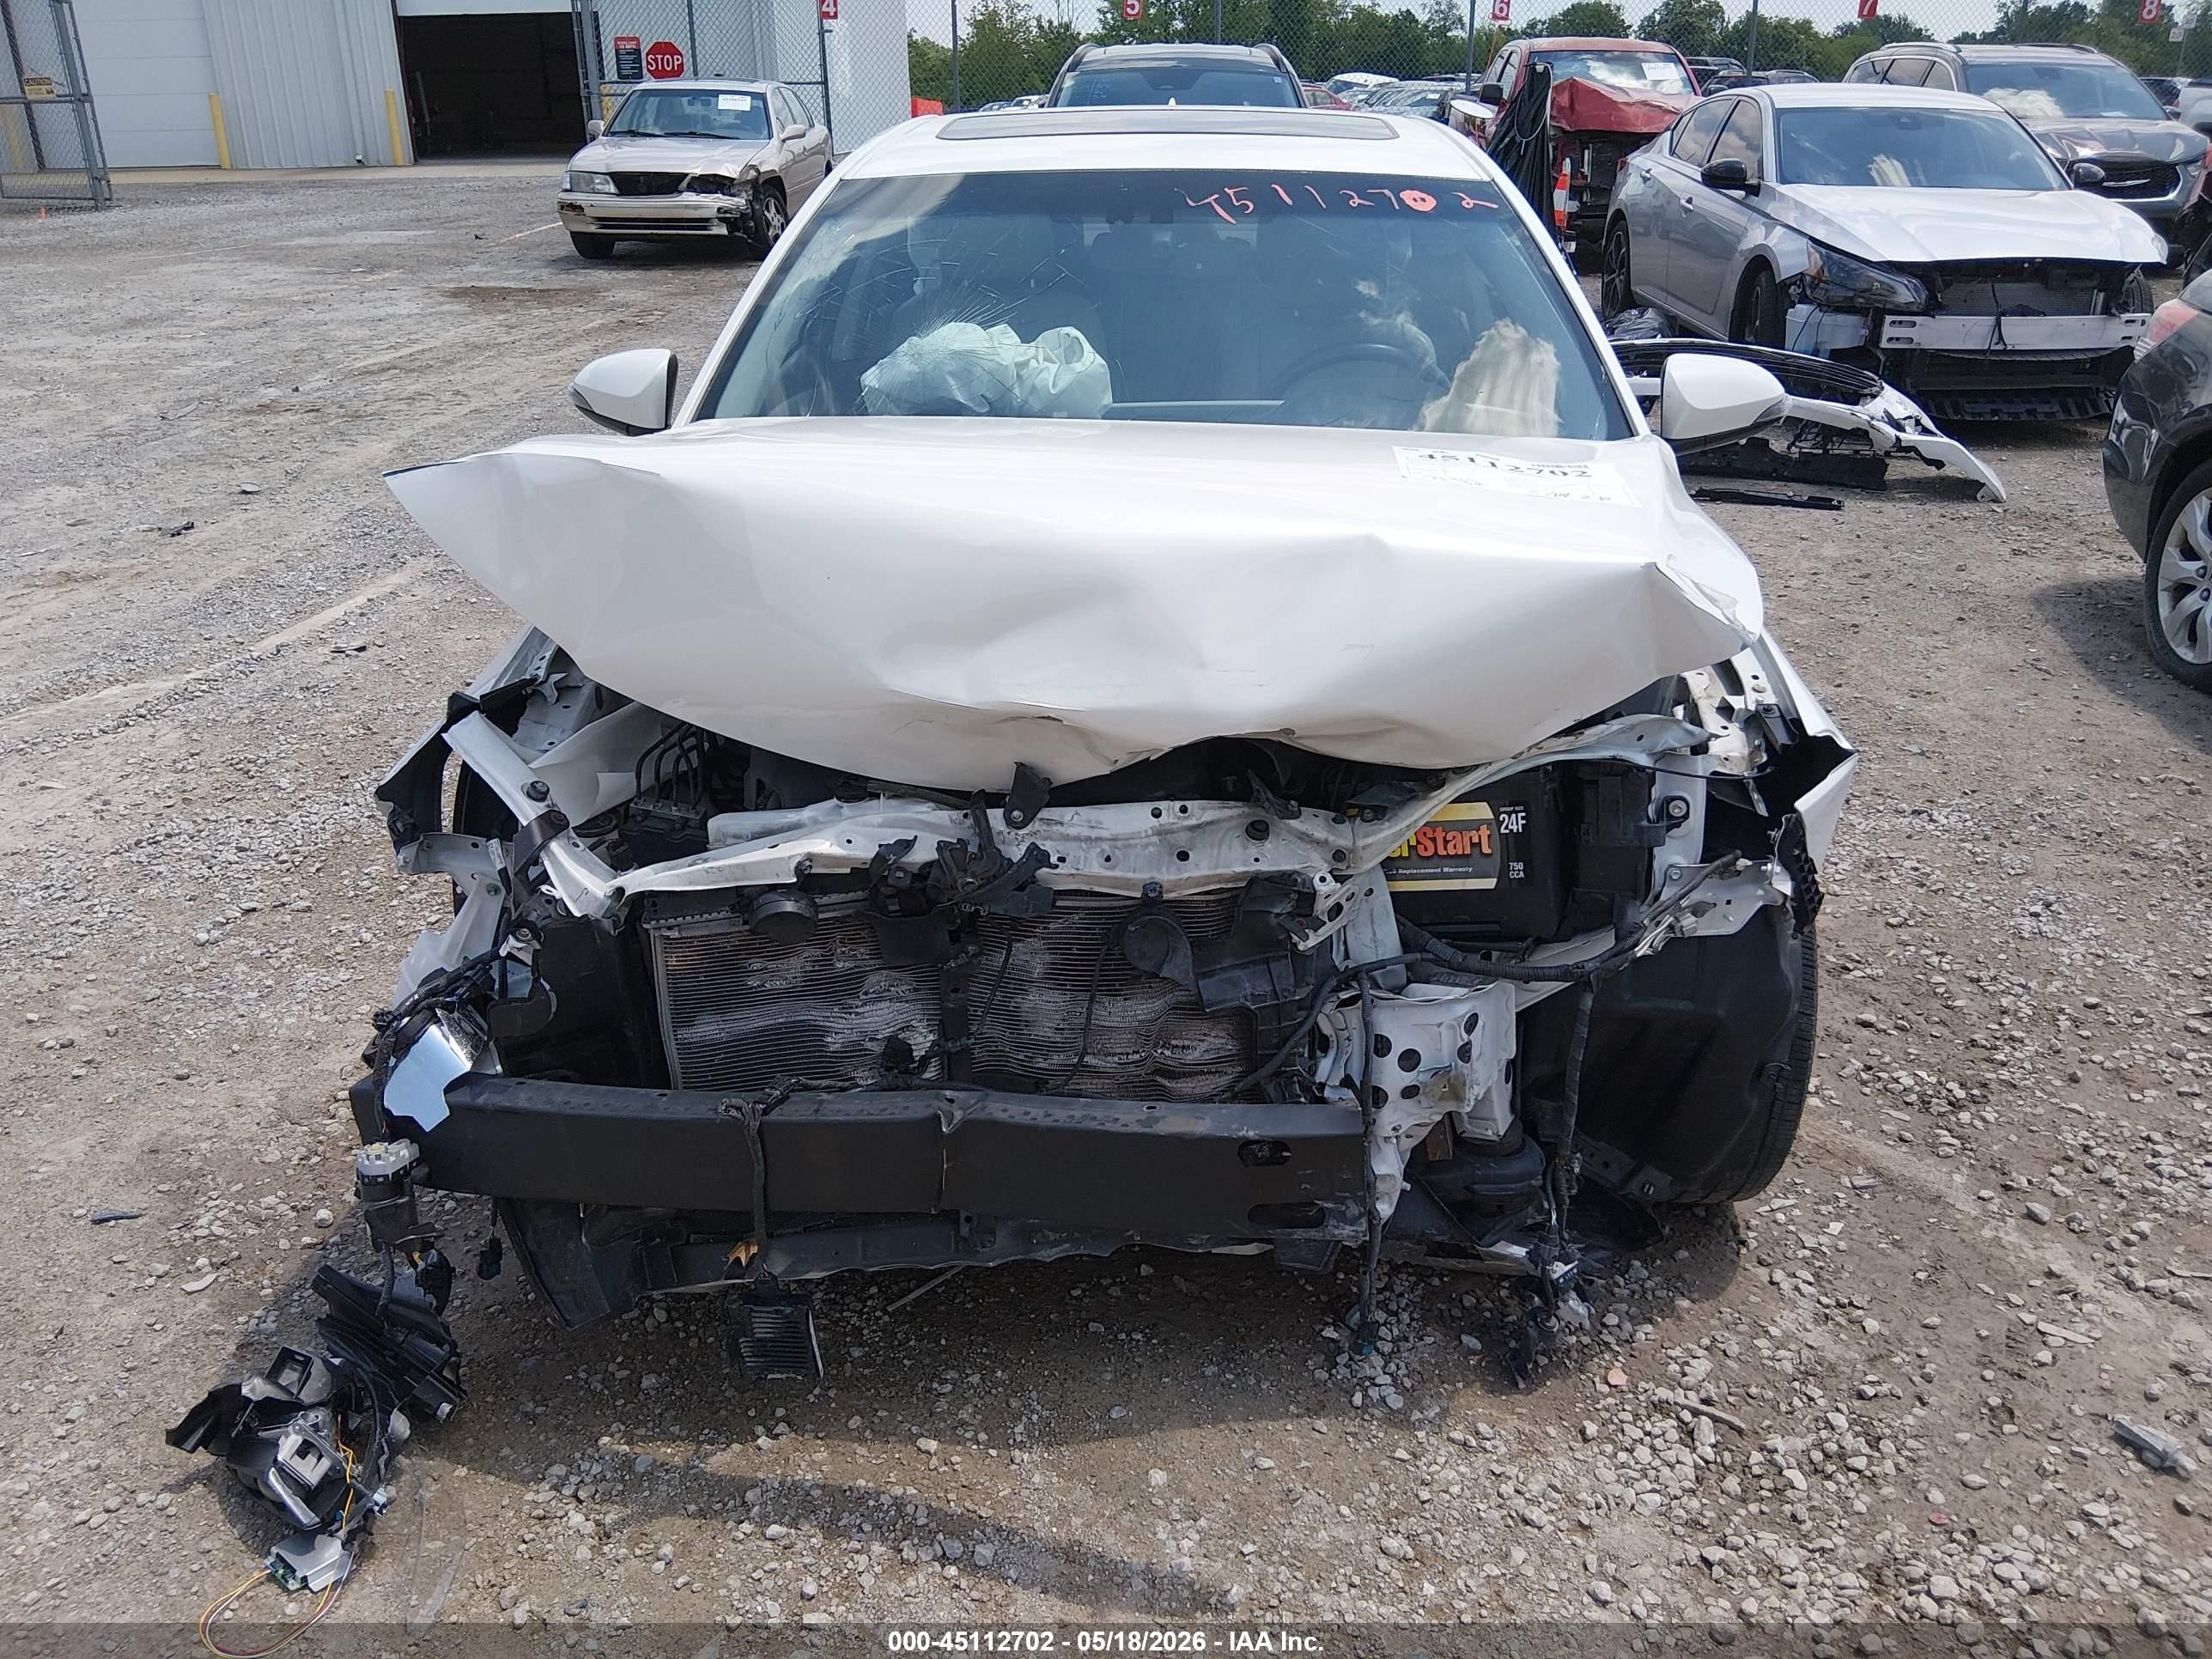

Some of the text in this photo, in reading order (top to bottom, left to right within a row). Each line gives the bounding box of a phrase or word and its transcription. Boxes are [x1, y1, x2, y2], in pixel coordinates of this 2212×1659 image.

[822, 0, 836, 16] 4
[1126, 0, 1140, 15] 5
[2142, 0, 2159, 20] 8
[647, 54, 683, 71] STOP
[1499, 812, 1527, 834] 24F
[1509, 862, 1524, 871] 750
[1509, 871, 1525, 879] CCA
